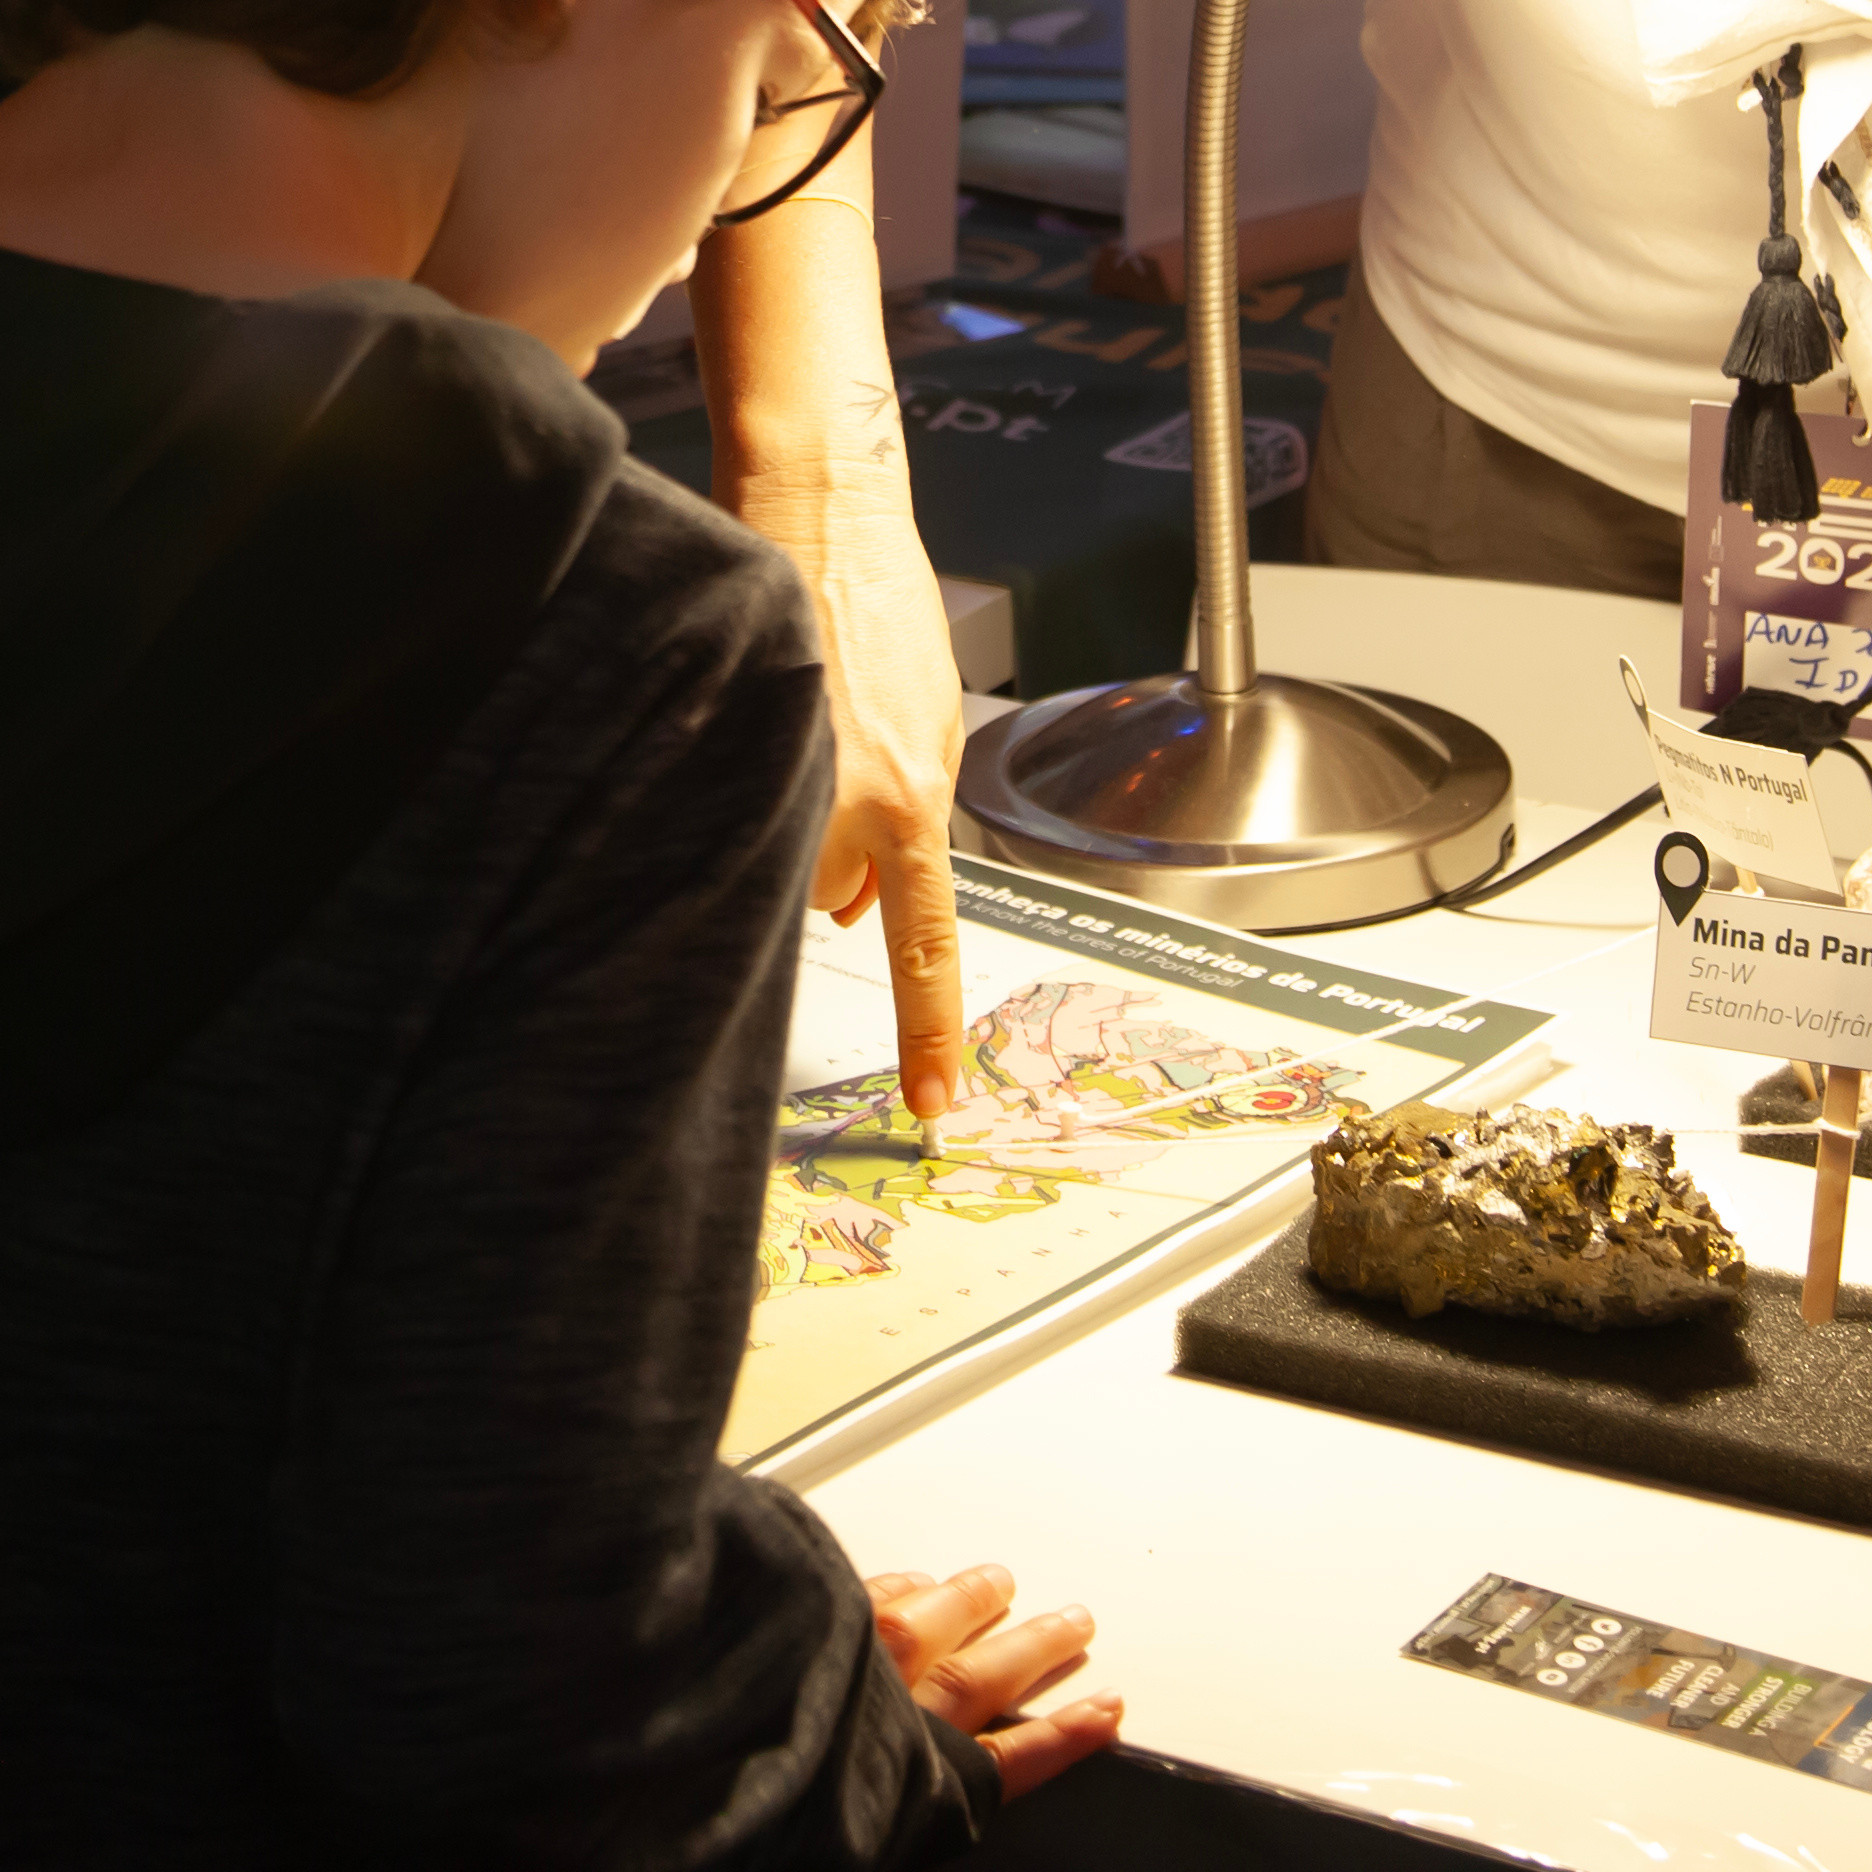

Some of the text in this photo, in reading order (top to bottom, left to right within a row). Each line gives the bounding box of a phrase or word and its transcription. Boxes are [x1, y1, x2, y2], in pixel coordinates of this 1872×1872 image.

[1746, 612, 1830, 649] ANA
[1719, 763, 1733, 786] N
[1735, 766, 1808, 804] Portugal
[971, 901, 1026, 926] know
[1031, 919, 1069, 938] the
[1069, 931, 1116, 952] ores
[1117, 944, 1146, 960] of
[1144, 955, 1244, 989] Portugal
[1069, 913, 1115, 934] os
[1114, 926, 1268, 979] minérios
[1269, 971, 1318, 993] de
[1692, 917, 1765, 952] Mina
[1775, 928, 1811, 958] da
[1689, 955, 1757, 985] Sn-W
[1645, 1658, 1695, 1699] FUTURE
[1670, 1664, 1725, 1709] CLEANER
[1709, 1681, 1741, 1707] AND
[1721, 1675, 1784, 1729] STRONGER
[1749, 1683, 1813, 1738] BUILDING A
